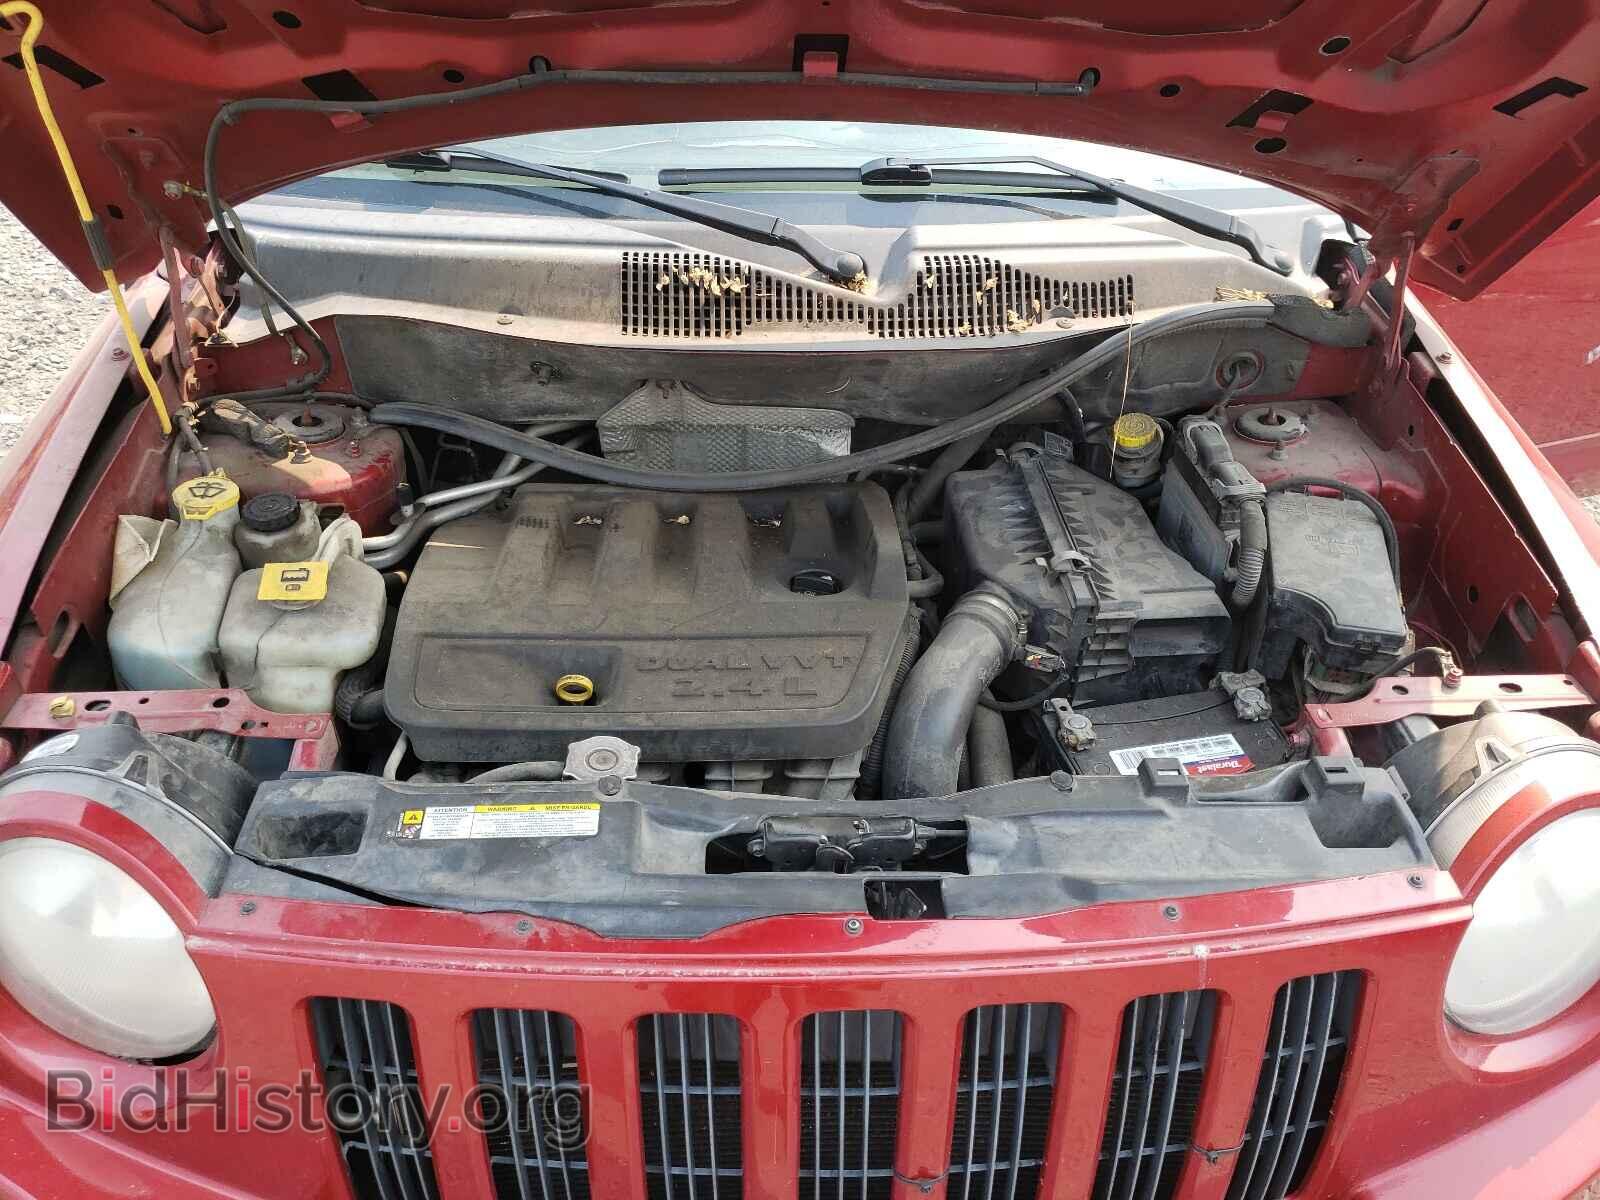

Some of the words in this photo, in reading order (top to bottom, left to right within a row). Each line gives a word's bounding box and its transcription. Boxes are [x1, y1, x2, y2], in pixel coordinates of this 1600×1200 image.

[636, 653, 750, 671] DUAL
[760, 652, 851, 670] VVT
[672, 679, 818, 697] 2.4L
[1196, 760, 1242, 774] Duralast
